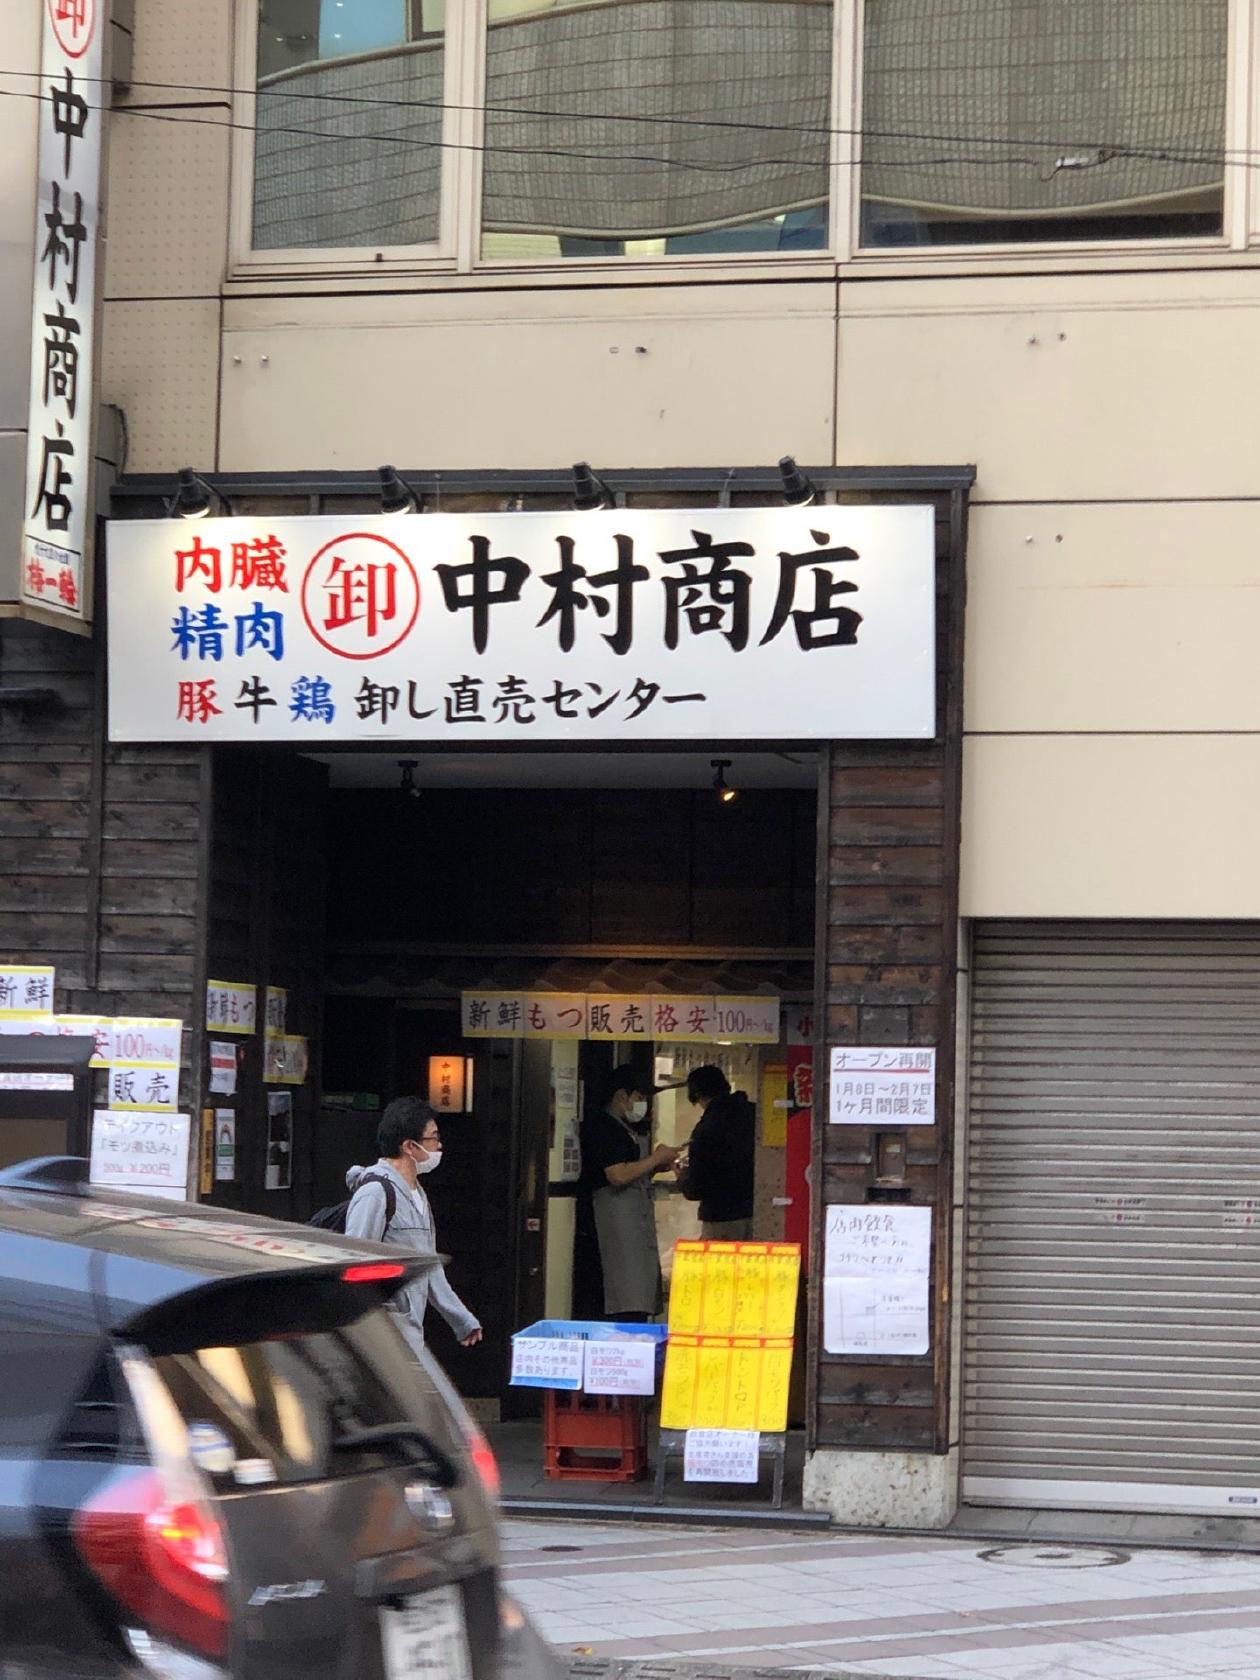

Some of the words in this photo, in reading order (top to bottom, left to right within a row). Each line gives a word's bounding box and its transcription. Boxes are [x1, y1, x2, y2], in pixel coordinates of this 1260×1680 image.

[32, 66, 88, 532] 中村商店
[173, 534, 290, 594] 内臓
[433, 529, 865, 655] 中村商店
[170, 602, 285, 661] 精肉
[114, 1071, 171, 1103] 販売
[835, 1052, 932, 1069] オープン再開
